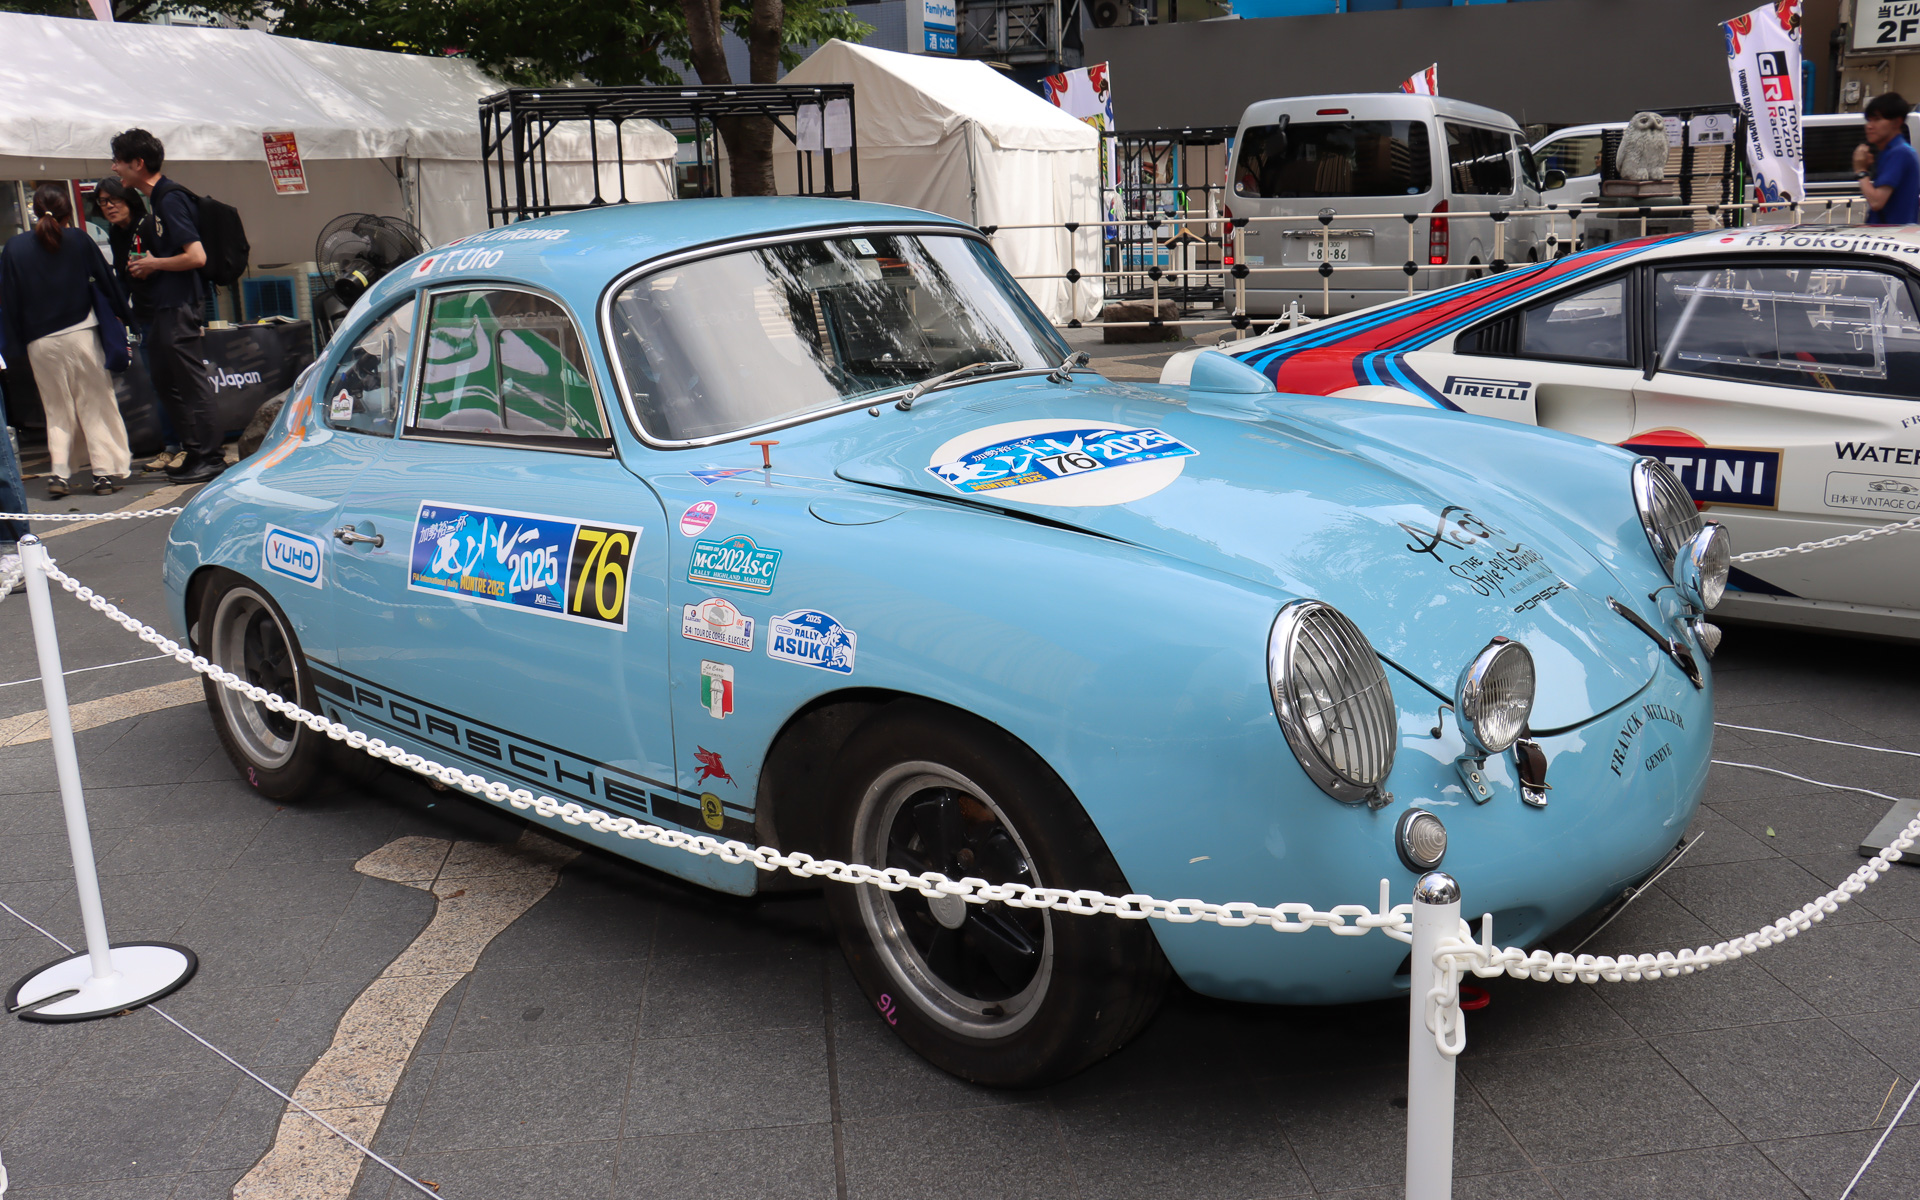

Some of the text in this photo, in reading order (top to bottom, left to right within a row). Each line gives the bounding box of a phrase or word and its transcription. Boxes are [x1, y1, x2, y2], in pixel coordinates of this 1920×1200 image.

[926, 2, 954, 18] FamilyMart
[1878, 3, 1920, 18] 当ビル
[929, 33, 954, 50] 酒 たばこ
[1876, 19, 1919, 44] 2F
[1758, 53, 1783, 101] GR
[1768, 106, 1784, 158] Racing
[1778, 106, 1795, 158] GAZOO
[438, 247, 504, 273] T.Uno
[1316, 248, 1346, 260] 8-86
[1442, 376, 1532, 400] PIRELLI
[1086, 431, 1178, 460] 2025
[1040, 452, 1097, 474] 76
[971, 474, 1048, 492] MONTRE 2025
[696, 504, 712, 512] OK
[1831, 494, 1858, 504] 日本平
[1860, 496, 1905, 508] VINTAGE
[273, 540, 313, 570] YUHO
[1461, 556, 1484, 572] THE
[508, 544, 558, 594] 2025
[573, 529, 630, 620] 76
[713, 572, 740, 580] HIGHLAND
[744, 576, 768, 585] MASTERS
[1449, 564, 1506, 598] Style
[460, 575, 505, 596] MONTRE 2025
[535, 594, 546, 604] JGR
[1514, 582, 1570, 614] PORSCHE
[805, 614, 822, 624] 2025
[694, 627, 705, 636] TOUR
[712, 630, 726, 642] CORSE
[795, 628, 819, 640] RALLY
[774, 636, 834, 662] ASUKA
[356, 686, 648, 814] PORSCHE
[1610, 704, 1685, 778] FRANCK MULLER
[1645, 742, 1673, 772] GENEVE
